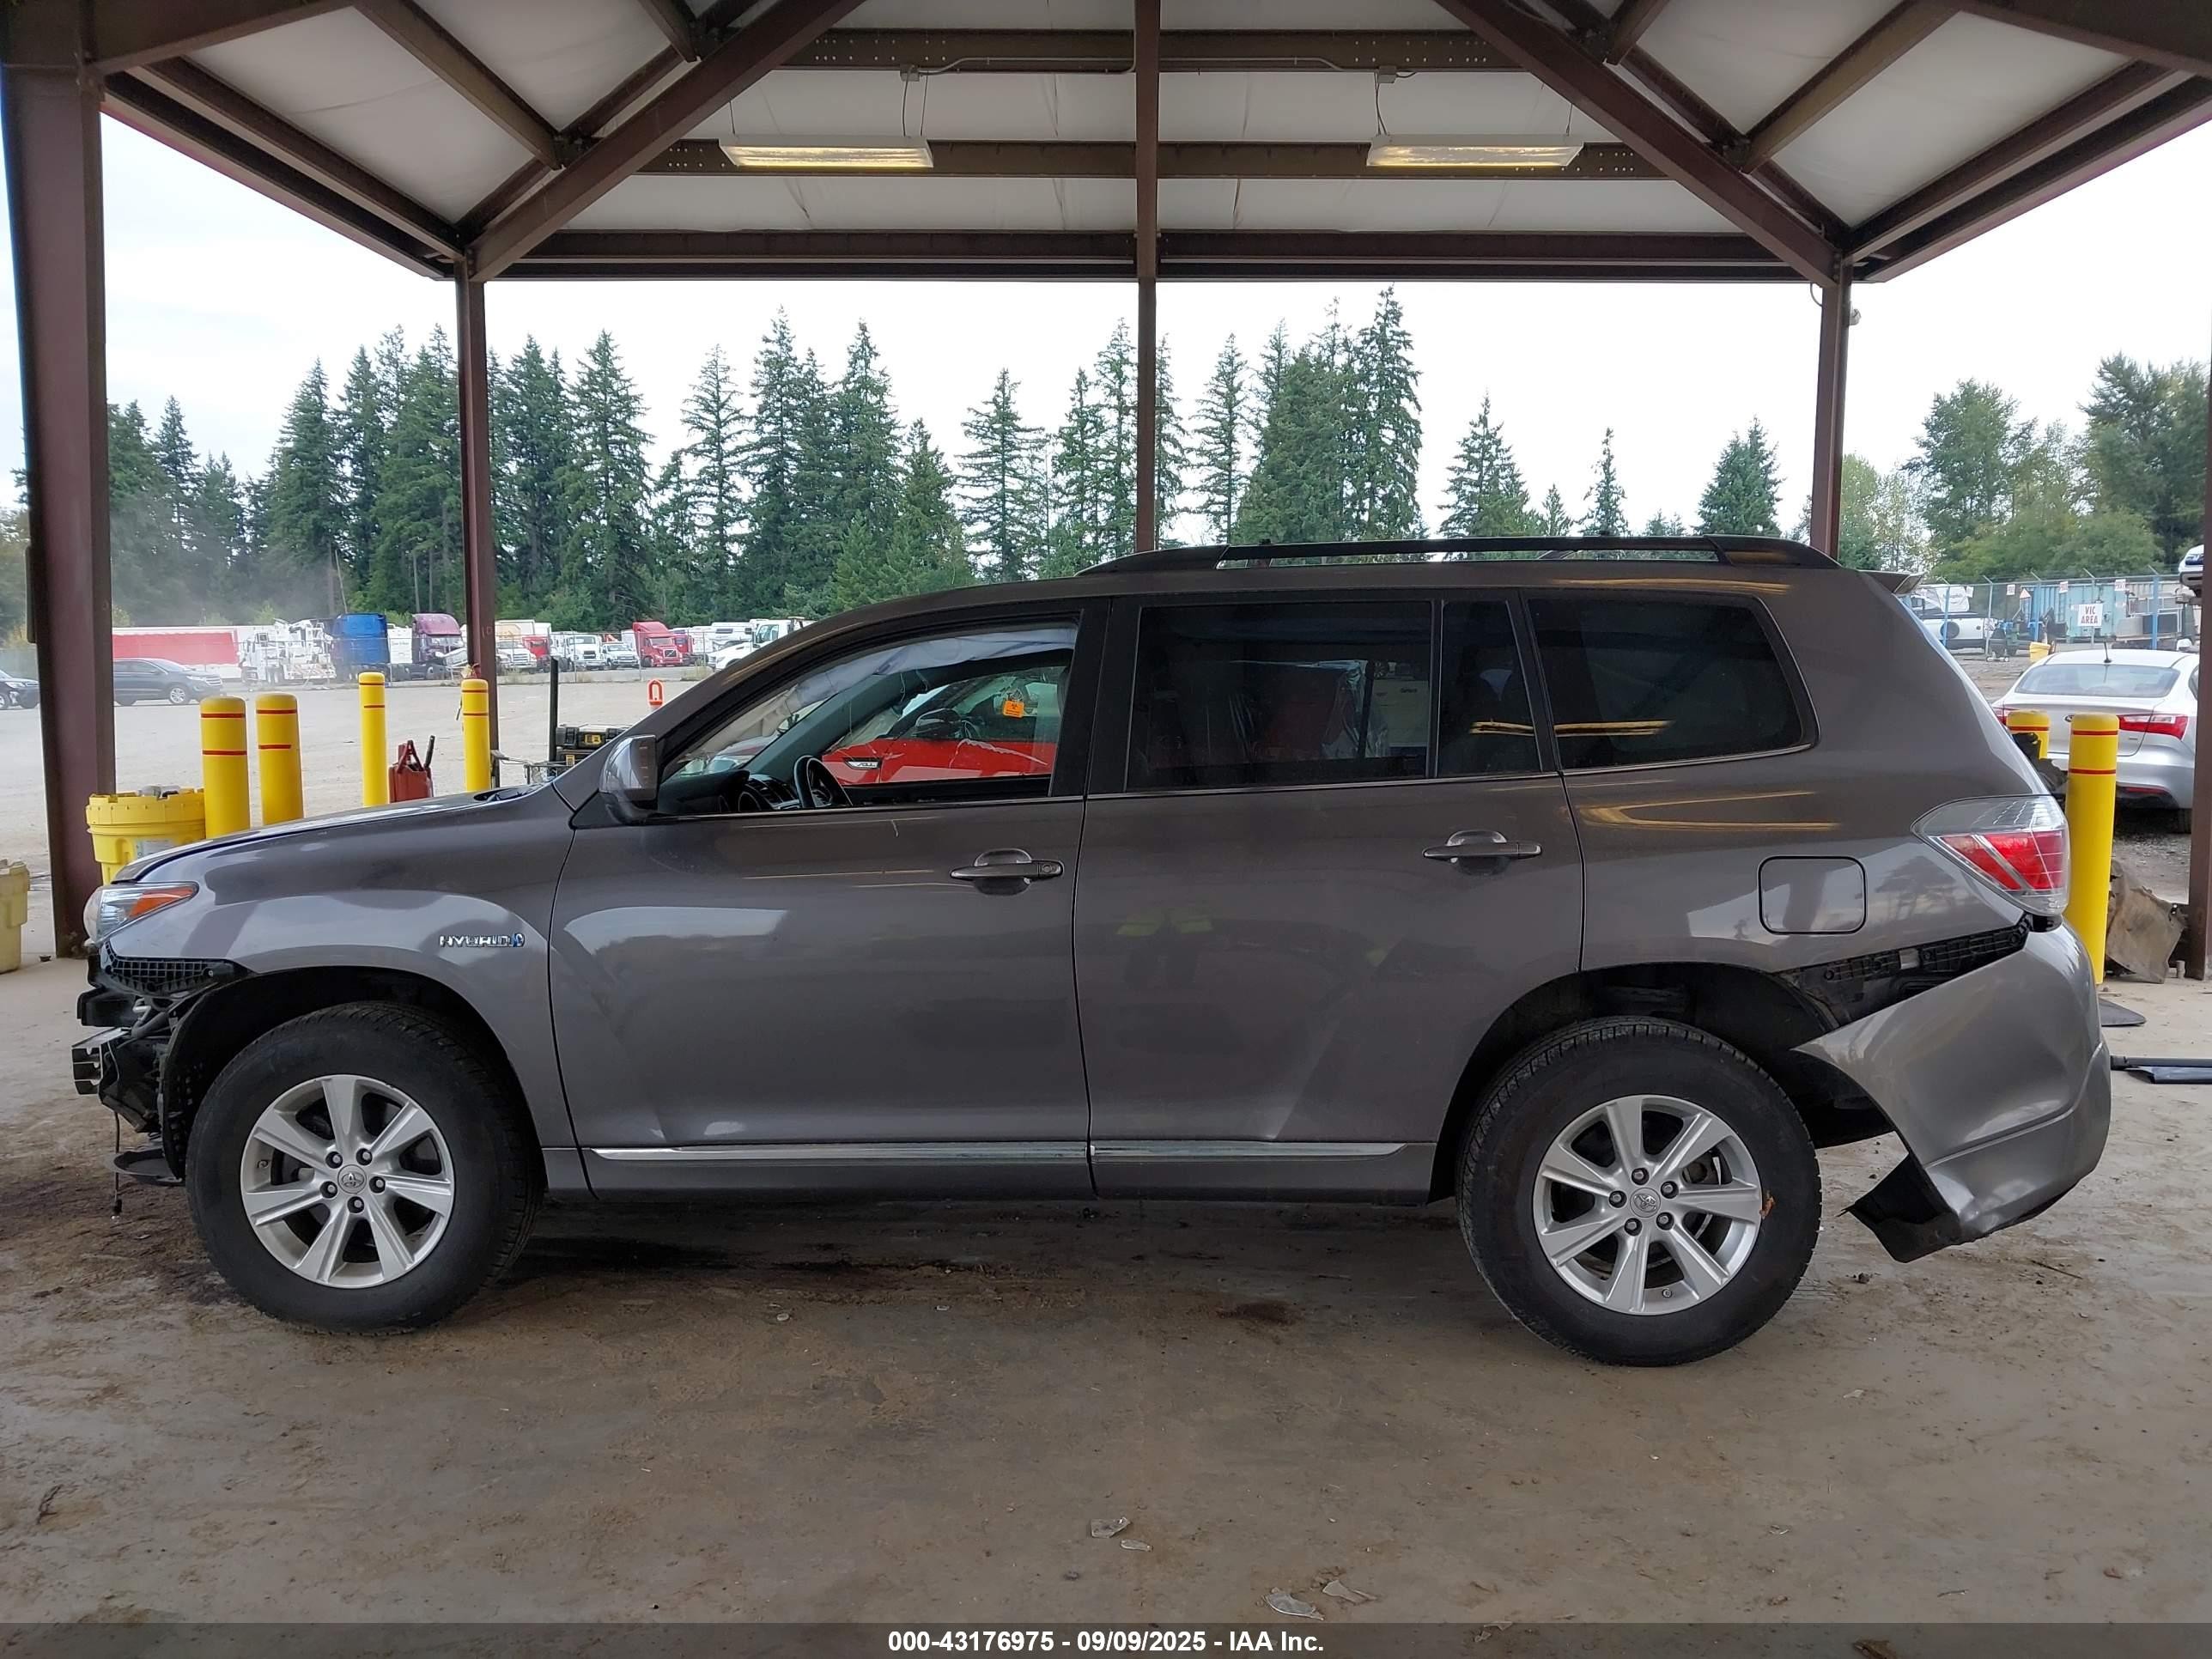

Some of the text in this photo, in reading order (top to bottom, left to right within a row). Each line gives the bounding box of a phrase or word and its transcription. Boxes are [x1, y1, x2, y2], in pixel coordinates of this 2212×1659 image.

[2085, 605, 2096, 615] VIC
[2081, 615, 2099, 624] AREA
[439, 935, 511, 947] HYBRID
